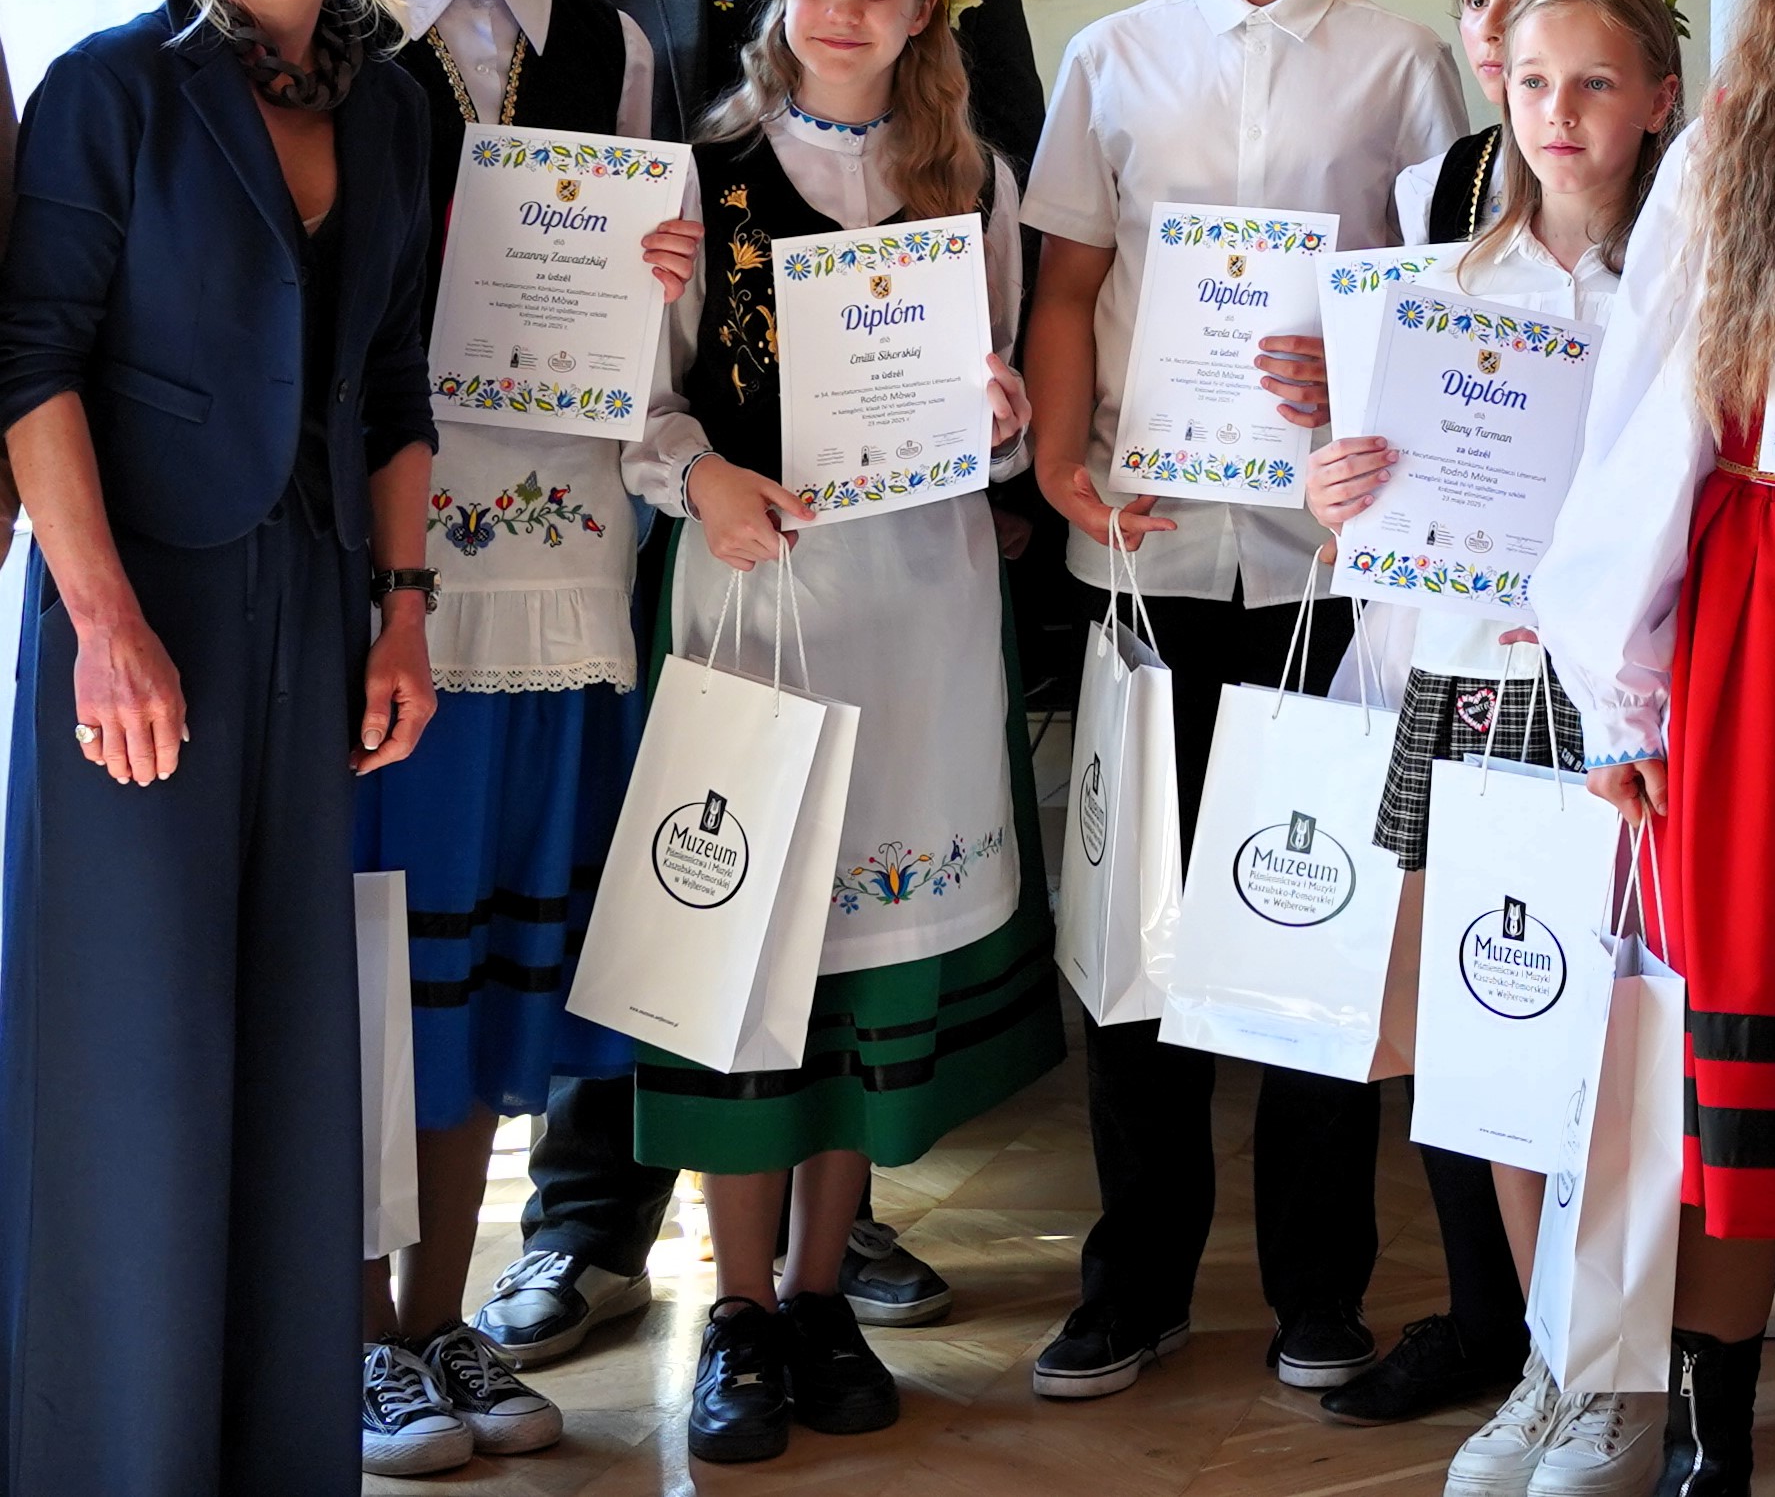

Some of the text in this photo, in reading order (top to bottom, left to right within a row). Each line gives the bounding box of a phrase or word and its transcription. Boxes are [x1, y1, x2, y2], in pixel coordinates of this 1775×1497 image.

[520, 201, 608, 235] Diplóm
[1198, 278, 1268, 311] Diplóm
[841, 299, 925, 335] Diplóm
[1442, 369, 1528, 410] Diplóm
[669, 822, 737, 867] Muzeum
[1252, 845, 1338, 884] Muzeum
[1475, 935, 1551, 972] Muzeum
